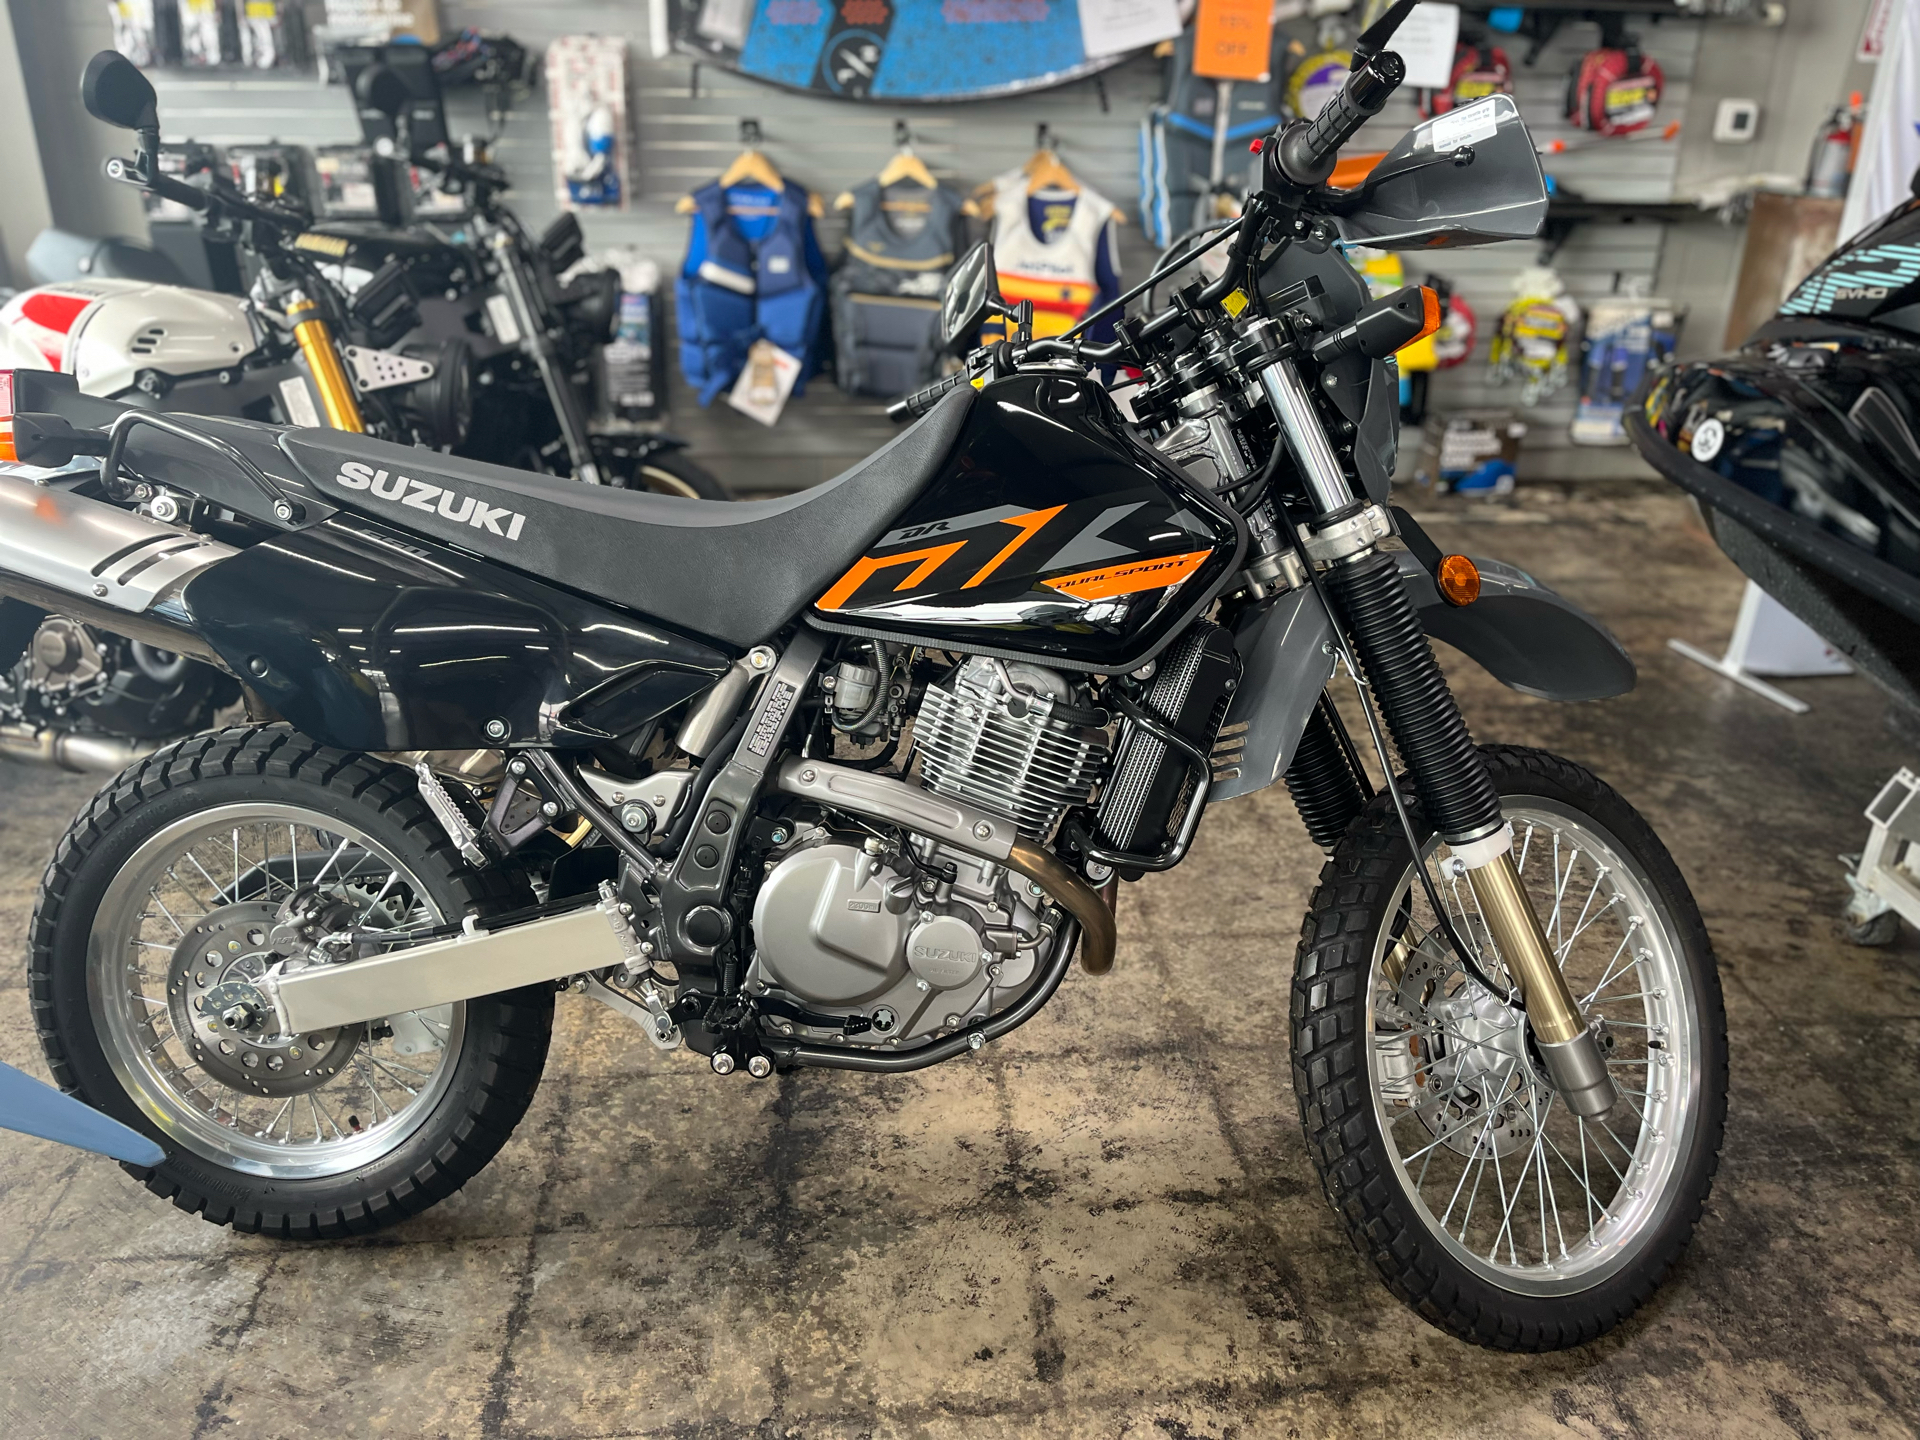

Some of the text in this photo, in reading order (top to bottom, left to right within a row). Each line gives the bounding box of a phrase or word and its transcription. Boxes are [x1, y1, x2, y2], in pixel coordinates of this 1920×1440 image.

[336, 461, 527, 541] SUZUKI
[898, 521, 951, 541] DR
[914, 945, 978, 964] SUZUKI
